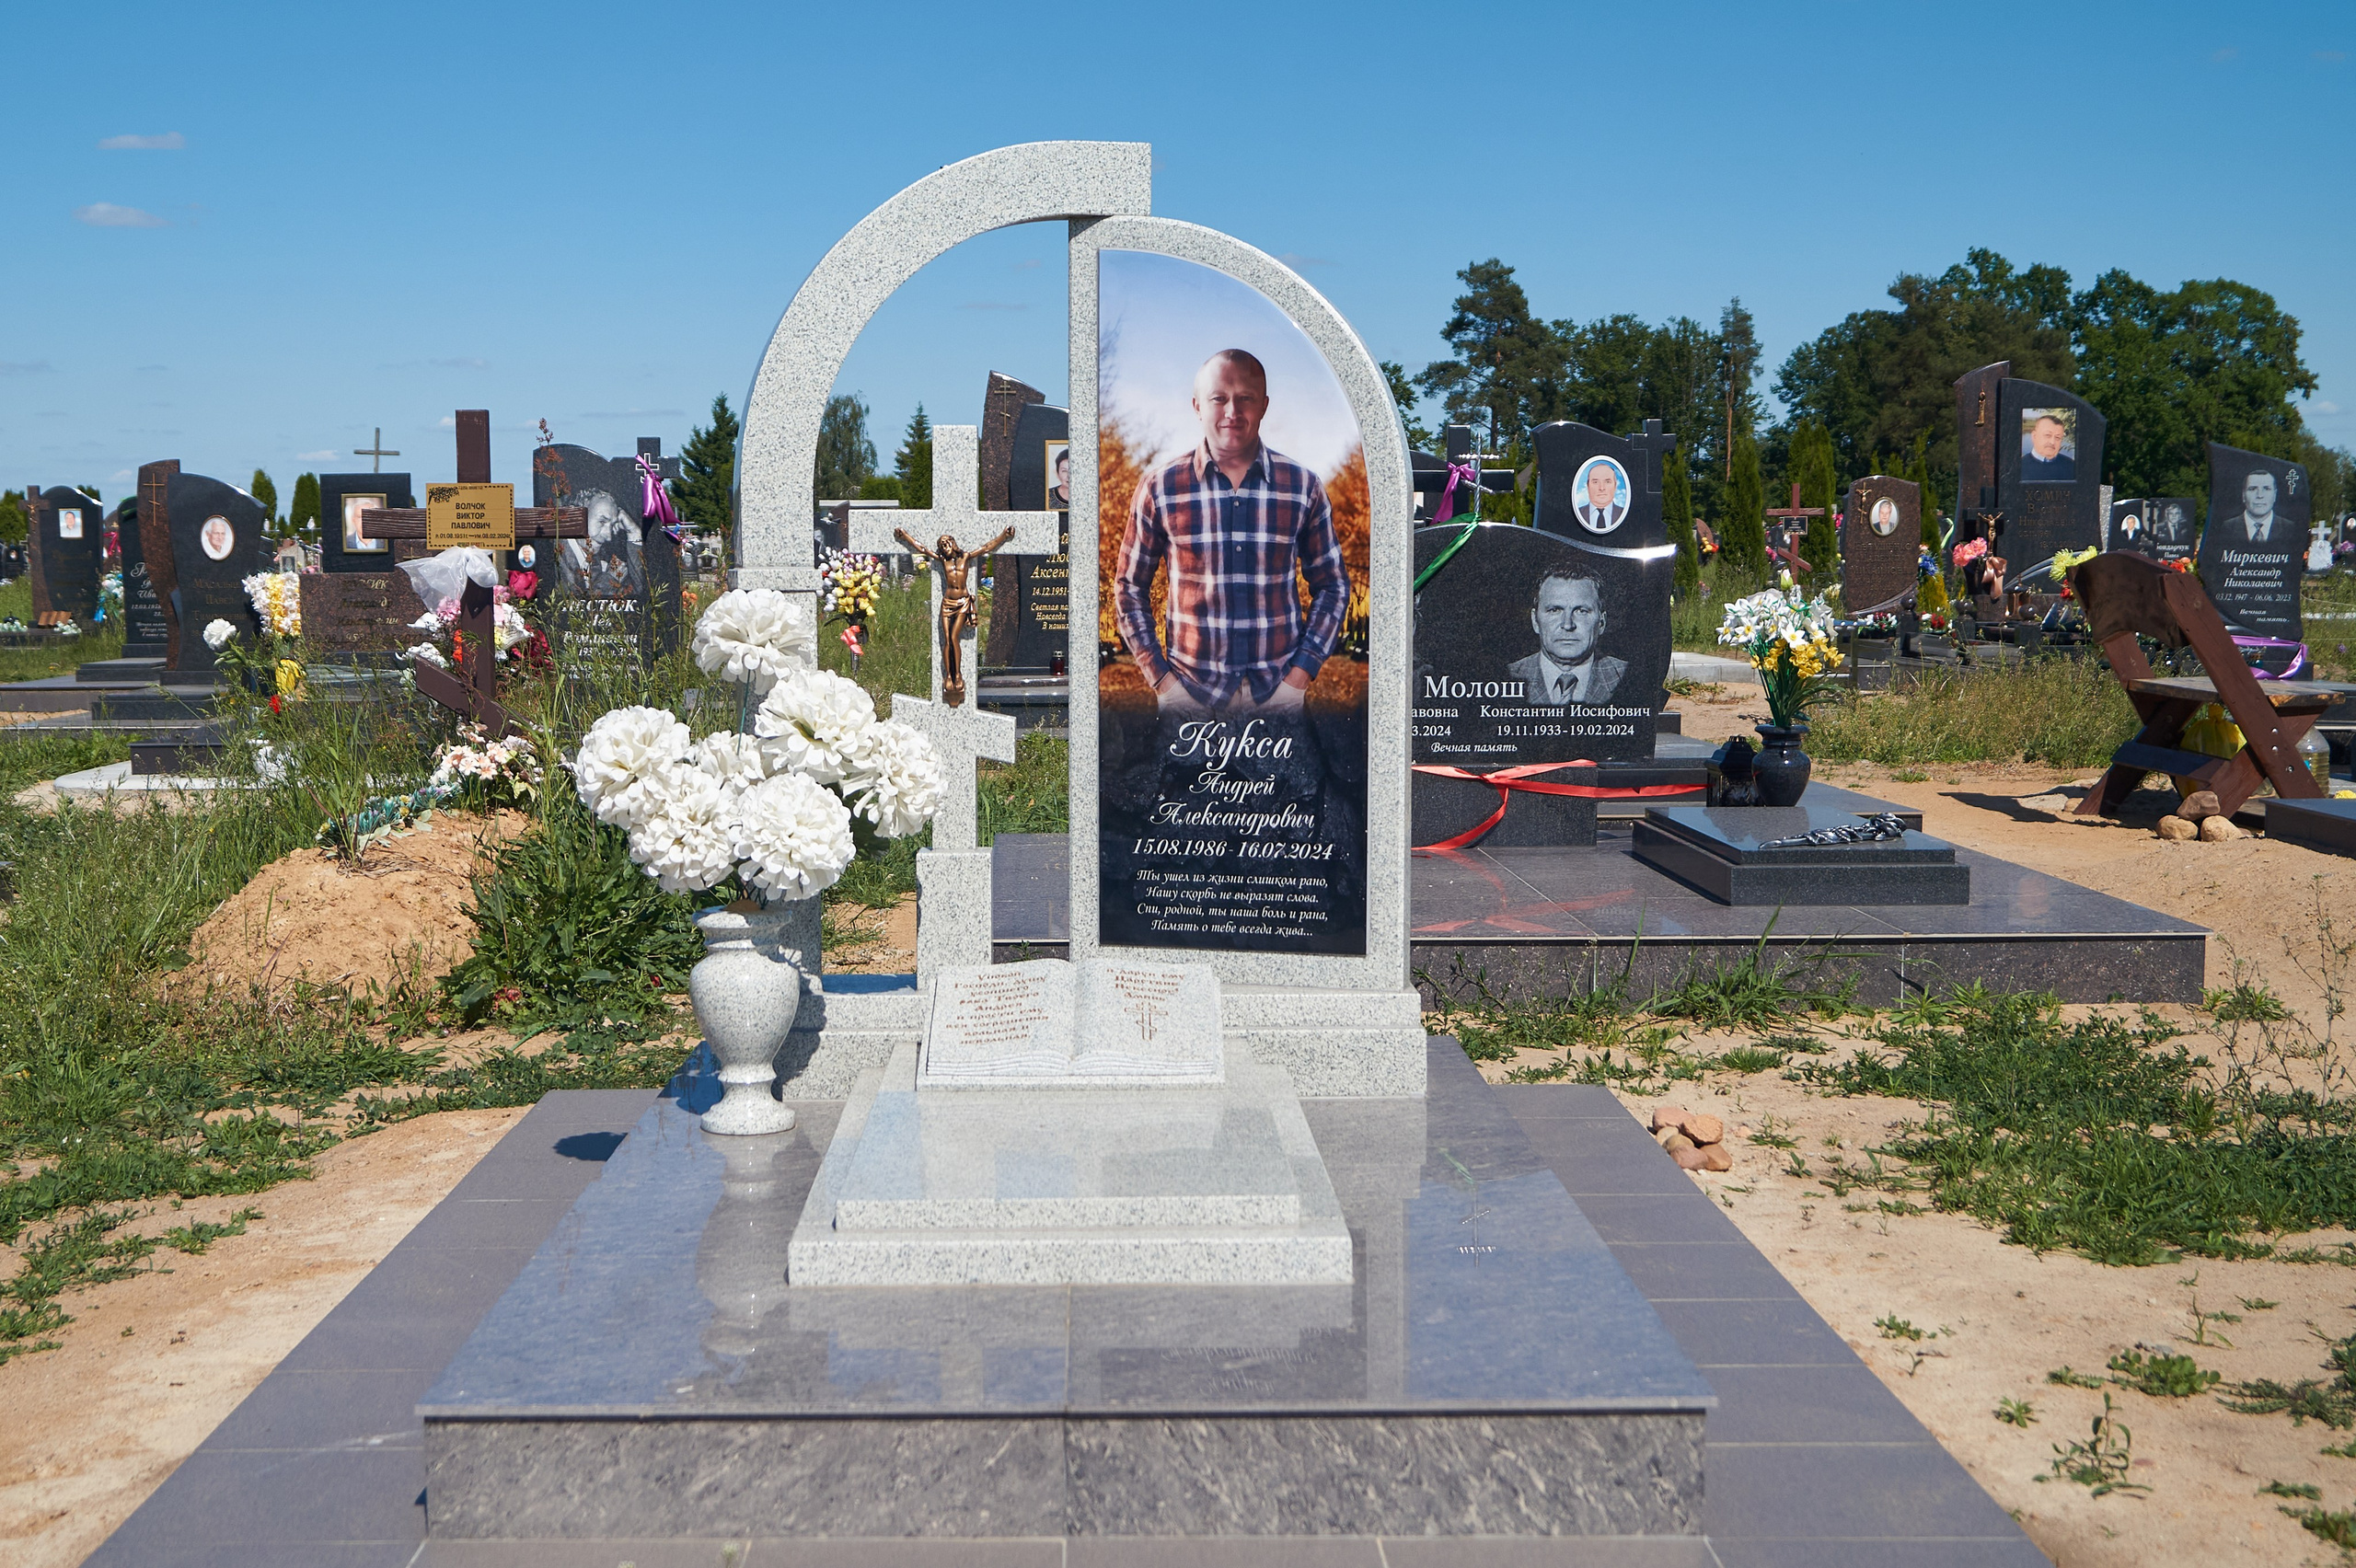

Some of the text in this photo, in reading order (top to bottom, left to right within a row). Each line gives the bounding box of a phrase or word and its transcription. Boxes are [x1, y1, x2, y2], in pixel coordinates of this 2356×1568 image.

[2220, 549, 2289, 567] Миркевич
[2223, 578, 2283, 588] Николаевич
[2229, 567, 2281, 580] Александр
[1031, 602, 1058, 611] Светлая
[1035, 611, 1067, 620] Навсегда
[1042, 621, 1047, 629] В
[1424, 675, 1525, 698] Молош
[1480, 704, 1651, 720] Константин Иосифович
[1170, 719, 1293, 771] Кукса
[1431, 742, 1518, 753] Вечная память
[1188, 771, 1276, 804] Андрей
[1149, 801, 1315, 838] Александрович
[1132, 838, 1228, 857] 15.08.1986
[1237, 841, 1334, 860] 16.07.2024
[1136, 869, 1161, 881] Ты
[1161, 872, 1190, 885] ушел
[1207, 874, 1243, 885] жизни
[1246, 875, 1297, 888] слишком
[1299, 877, 1328, 889] рано,
[1145, 885, 1319, 905] Нашу скорбь не выразят слова.
[1137, 903, 1328, 923] Спи, родной, ты наша боль и рана,
[1150, 918, 1313, 939] Память о тебе всегда жива...
